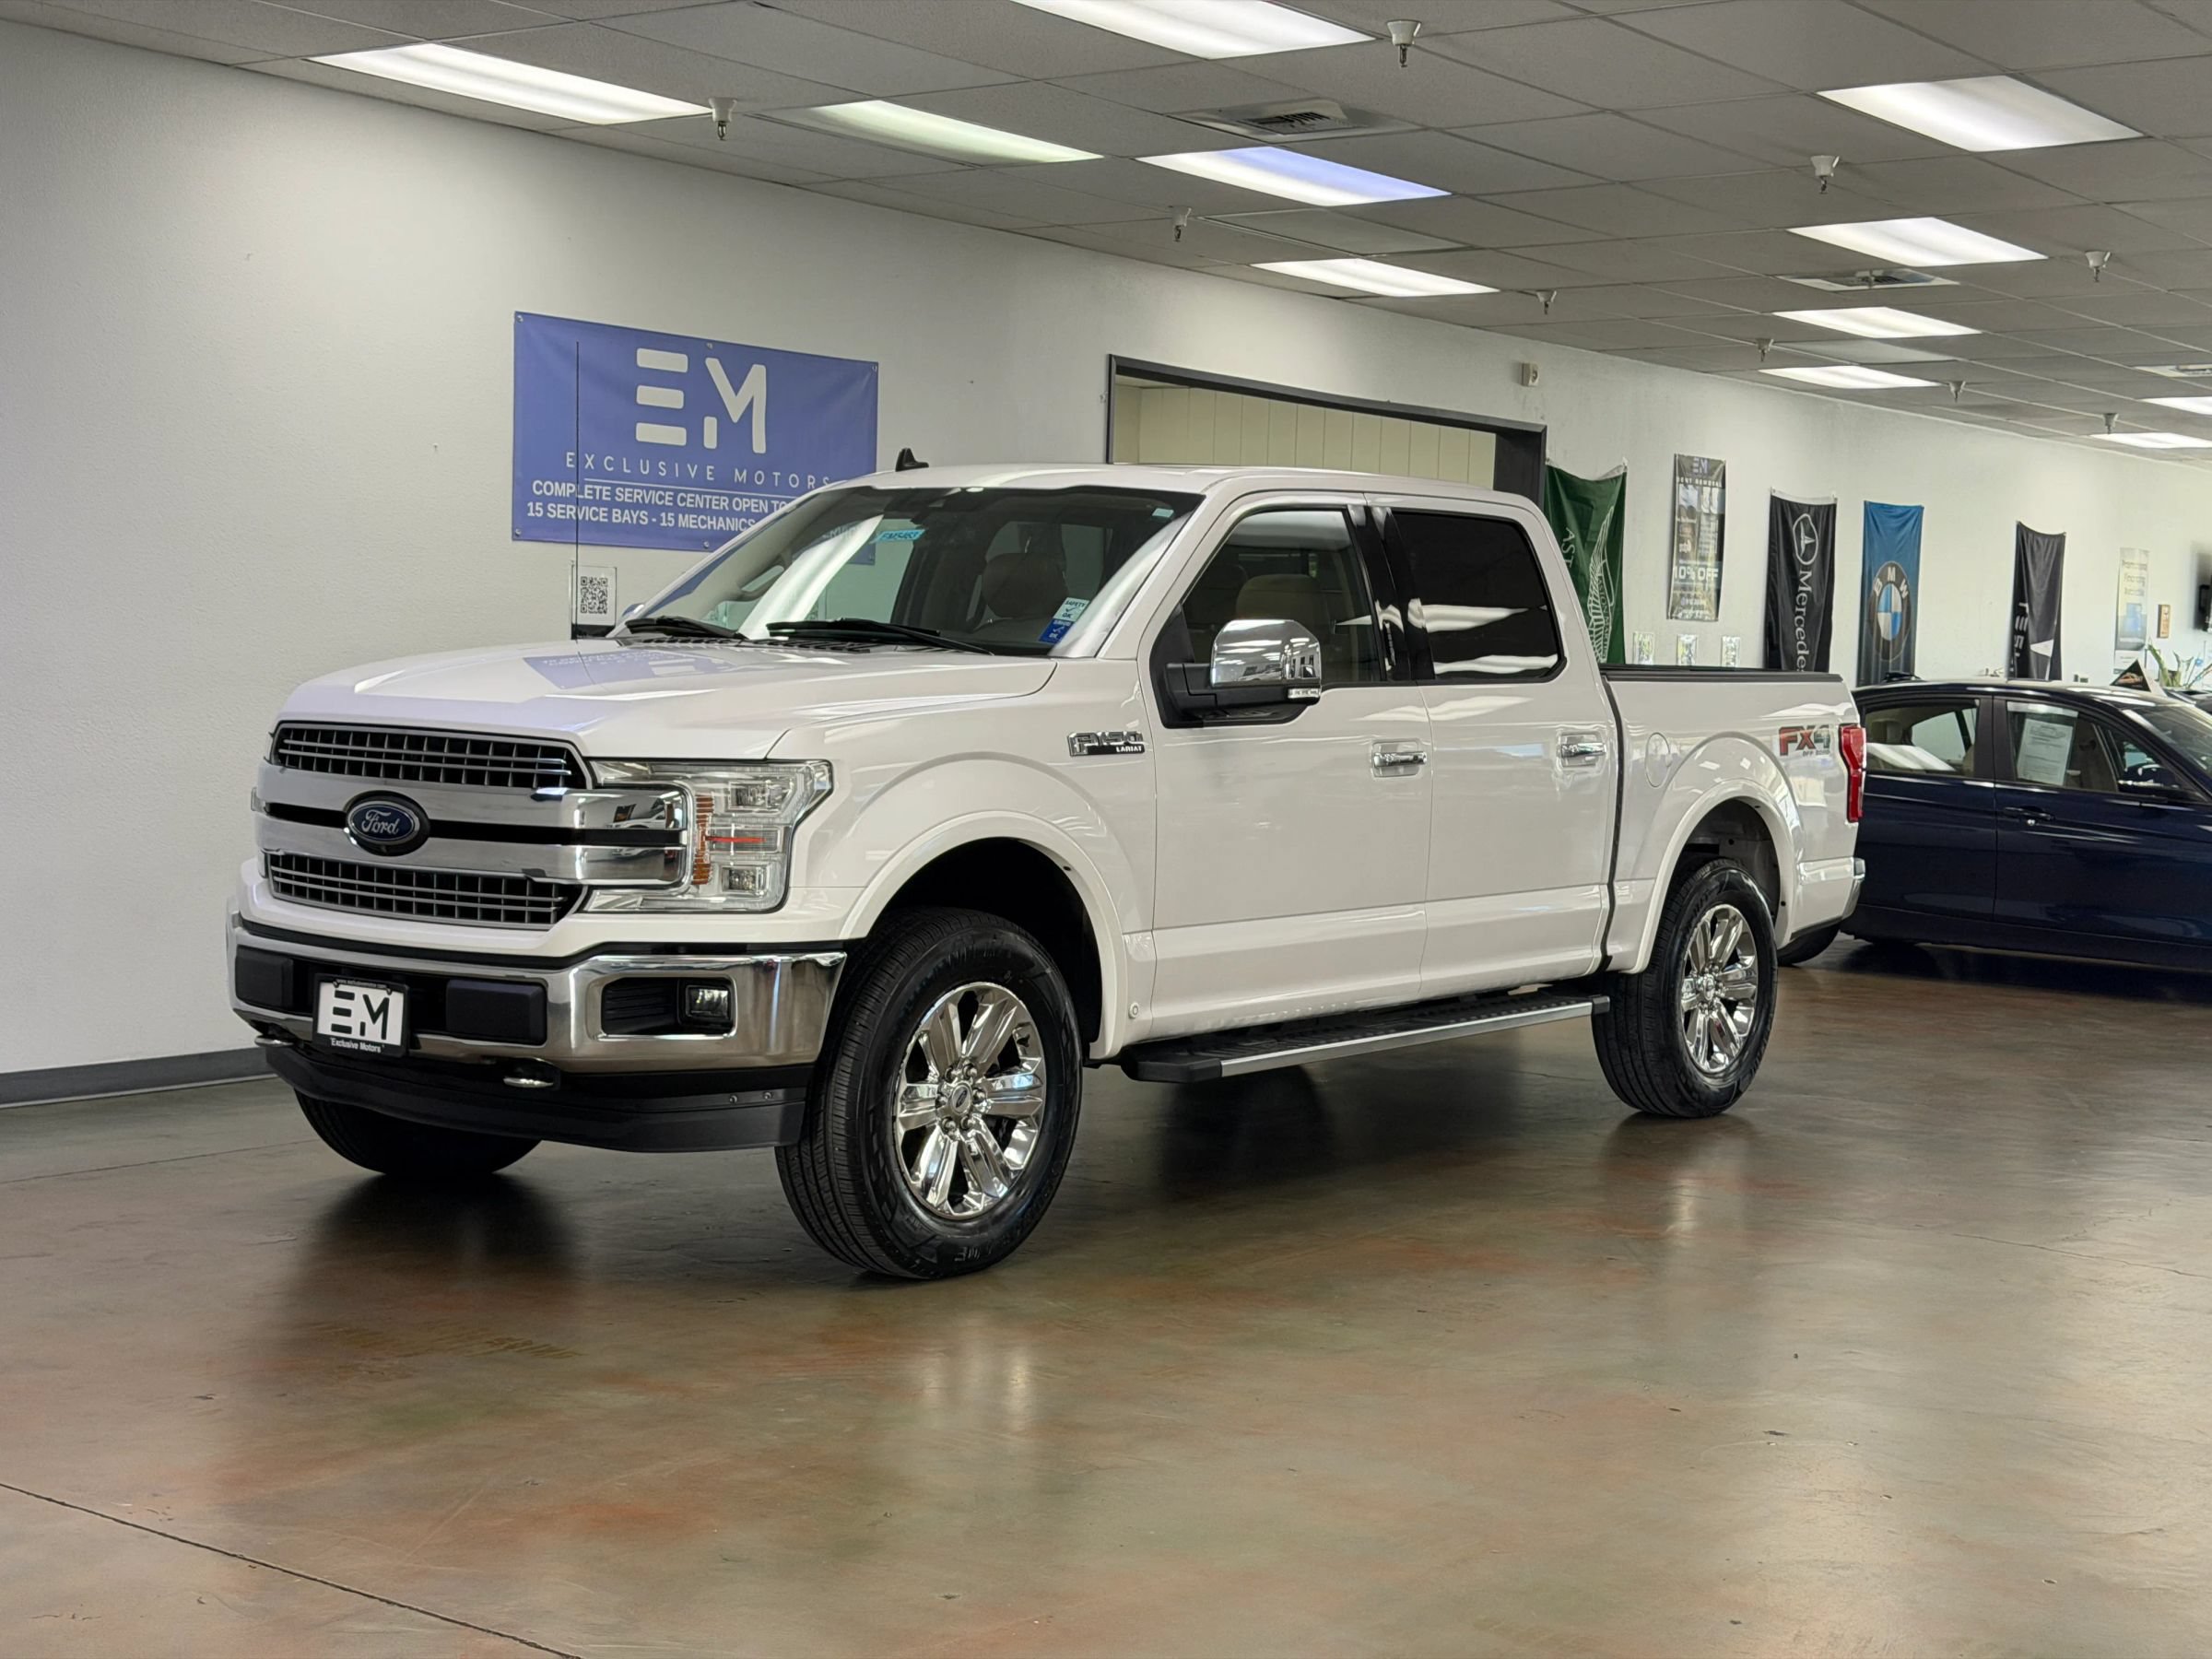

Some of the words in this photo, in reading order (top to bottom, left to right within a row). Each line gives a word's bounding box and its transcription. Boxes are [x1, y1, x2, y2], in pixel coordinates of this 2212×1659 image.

[636, 347, 767, 454] EM
[566, 452, 715, 481] EXCLUSIVE
[734, 468, 830, 489] MOTORS
[532, 479, 611, 501] COMPLETE
[615, 487, 674, 507] SERVICE
[677, 492, 729, 511] CENTER
[732, 497, 769, 513] OPEN
[527, 501, 543, 517] 15
[547, 503, 608, 523] SERVICE
[612, 509, 649, 525] BAYS
[660, 512, 675, 527] 15
[1698, 567, 1719, 582] OFF
[1874, 566, 1909, 598] BMW
[1794, 570, 1812, 672] Mercede
[1115, 745, 1143, 753] LARIAT
[1779, 724, 1830, 757] FX4
[360, 809, 401, 835] Ford
[331, 990, 390, 1041] EM
